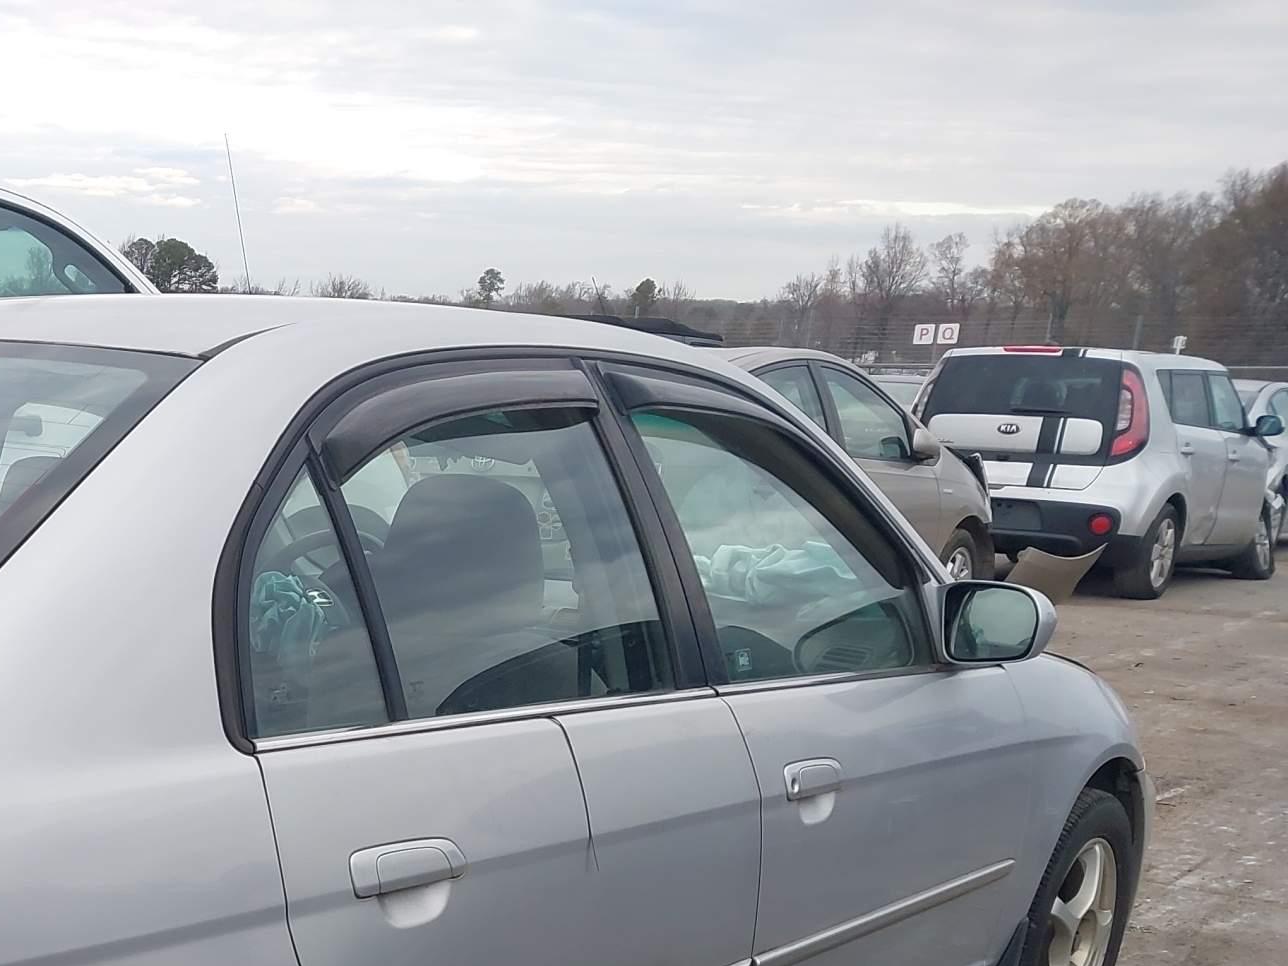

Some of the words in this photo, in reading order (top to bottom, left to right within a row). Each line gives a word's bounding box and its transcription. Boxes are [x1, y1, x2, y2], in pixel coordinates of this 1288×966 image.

[919, 327, 930, 341] P
[942, 327, 955, 341] Q
[999, 424, 1018, 433] KIA
